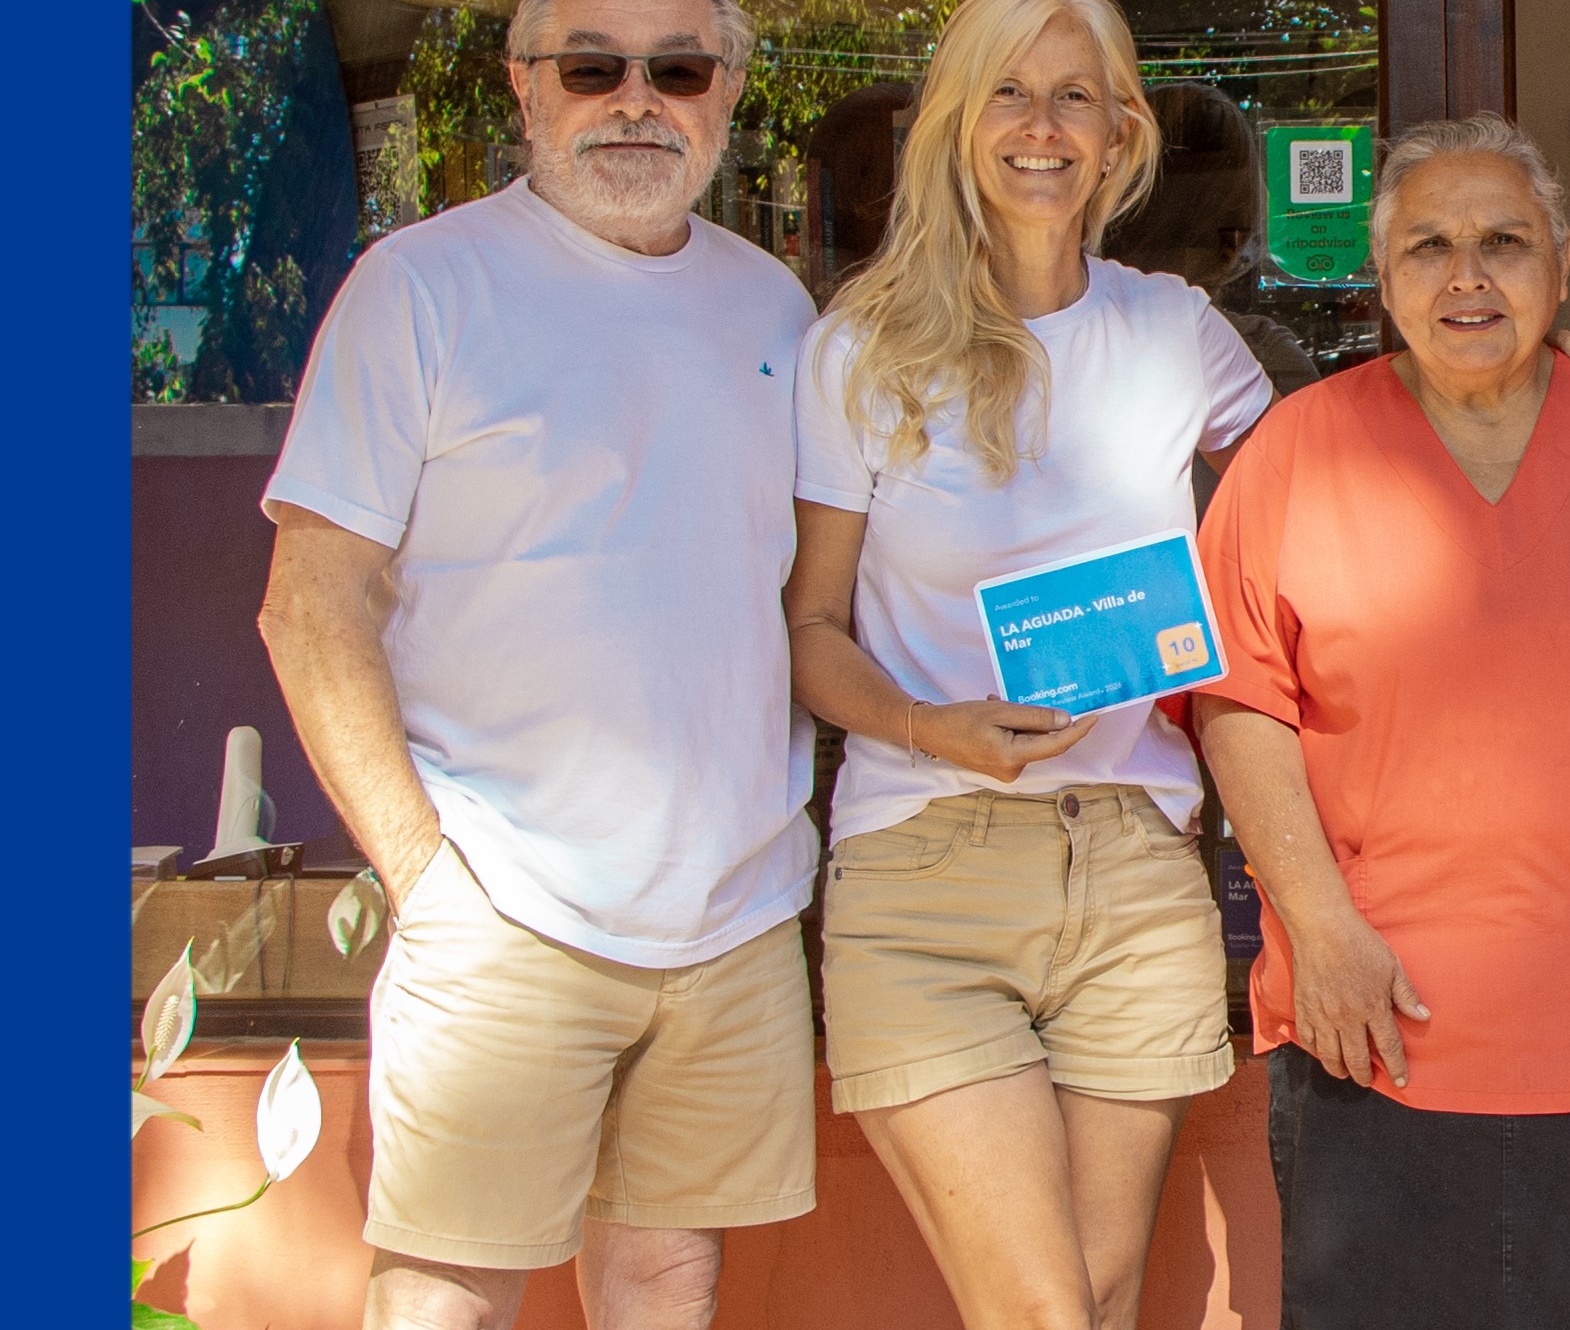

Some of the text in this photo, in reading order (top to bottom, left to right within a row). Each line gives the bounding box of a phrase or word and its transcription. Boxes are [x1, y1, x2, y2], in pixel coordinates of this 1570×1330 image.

[1286, 208, 1351, 220] Review us
[1311, 225, 1327, 234] on
[1284, 236, 1357, 250] Tripadvisor
[1030, 595, 1040, 603] to
[1000, 622, 1020, 638] LA
[1022, 606, 1085, 633] AGUADA
[1093, 595, 1125, 613] Villa
[1127, 589, 1146, 604] de
[1004, 637, 1032, 653] Mar
[1170, 637, 1195, 656] 10
[1017, 682, 1078, 705] Booking.com
[1228, 880, 1241, 890] LA
[1228, 892, 1249, 901] Mar
